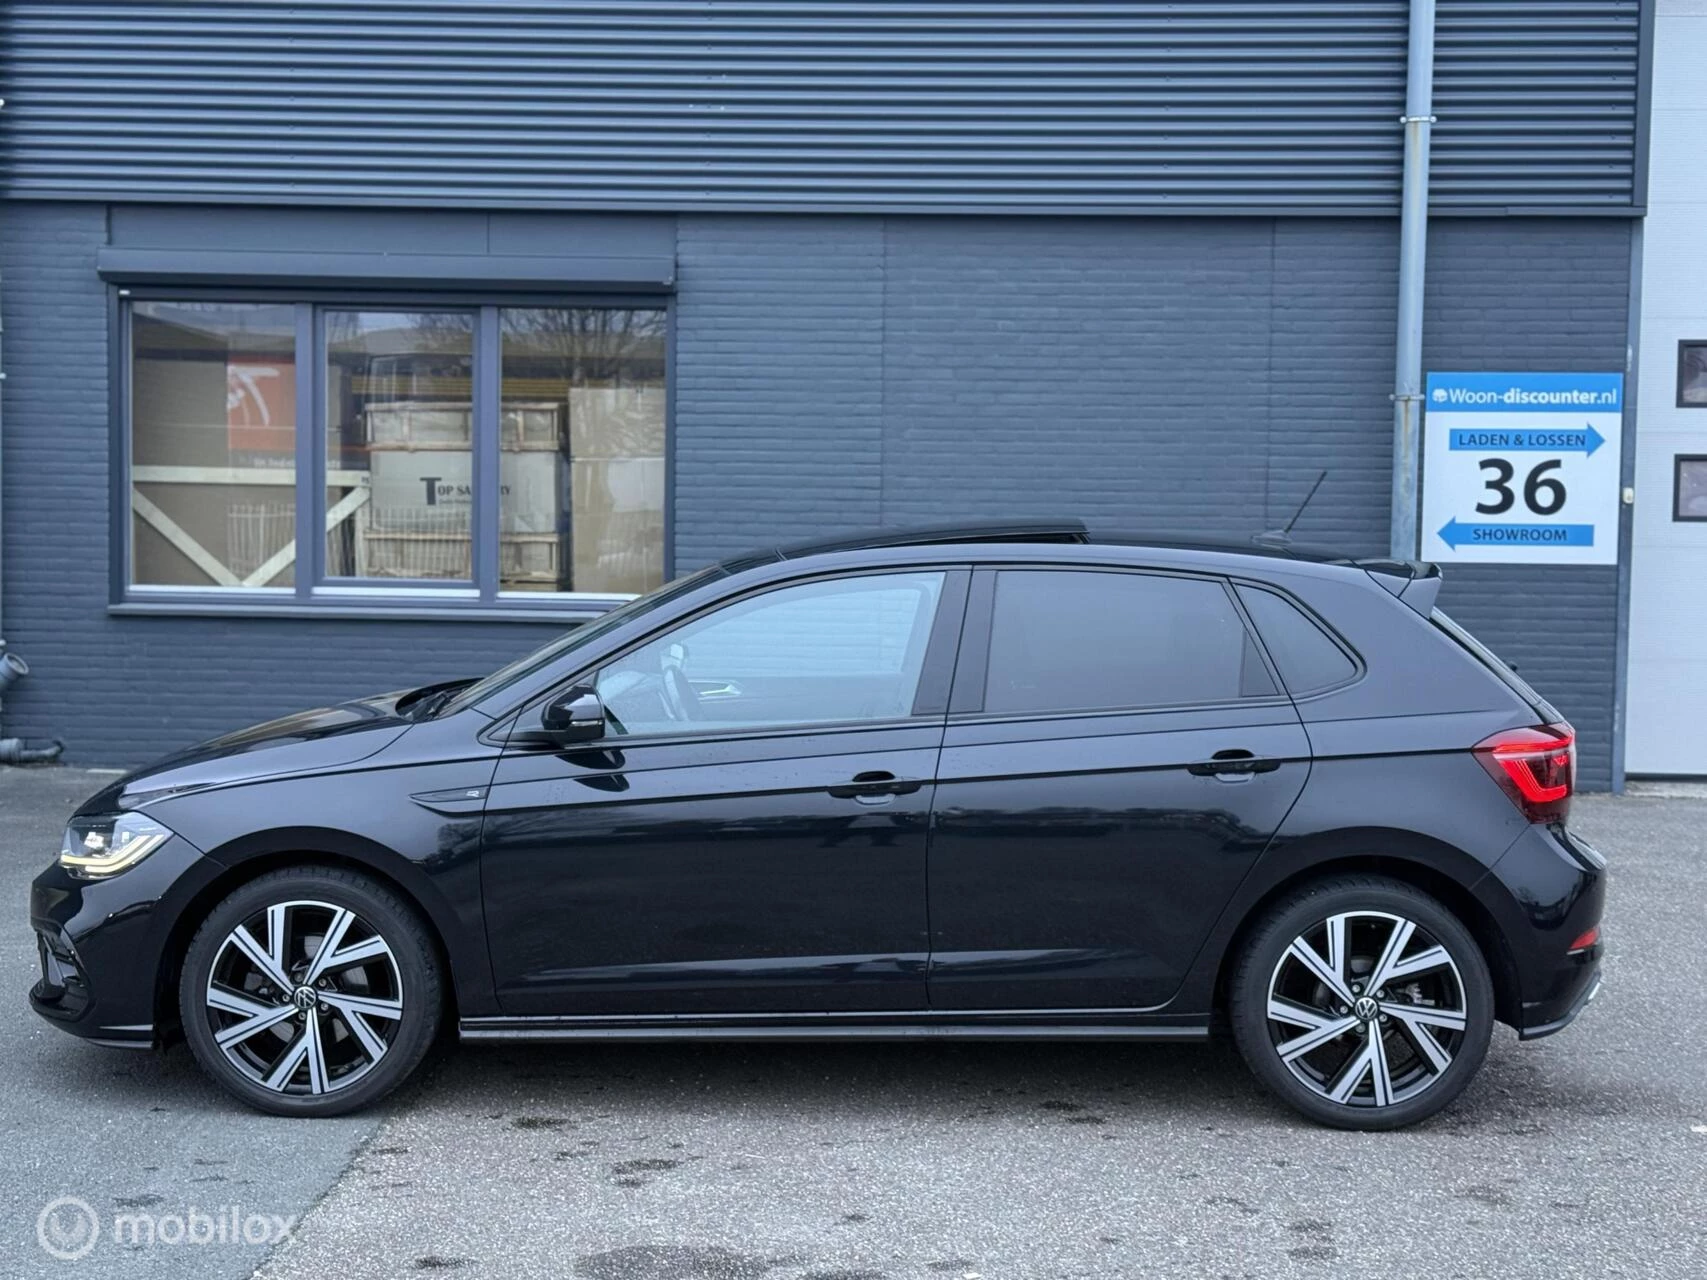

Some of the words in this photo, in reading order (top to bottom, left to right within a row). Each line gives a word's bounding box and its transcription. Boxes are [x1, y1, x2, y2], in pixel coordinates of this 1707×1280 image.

[1449, 388, 1617, 404] Woon-discounter.nl
[1458, 434, 1509, 446] LADEN
[1513, 434, 1525, 446] &
[1528, 435, 1586, 447] LOSSEN
[1475, 458, 1567, 516] 36
[1472, 528, 1567, 541] SHOWROOM
